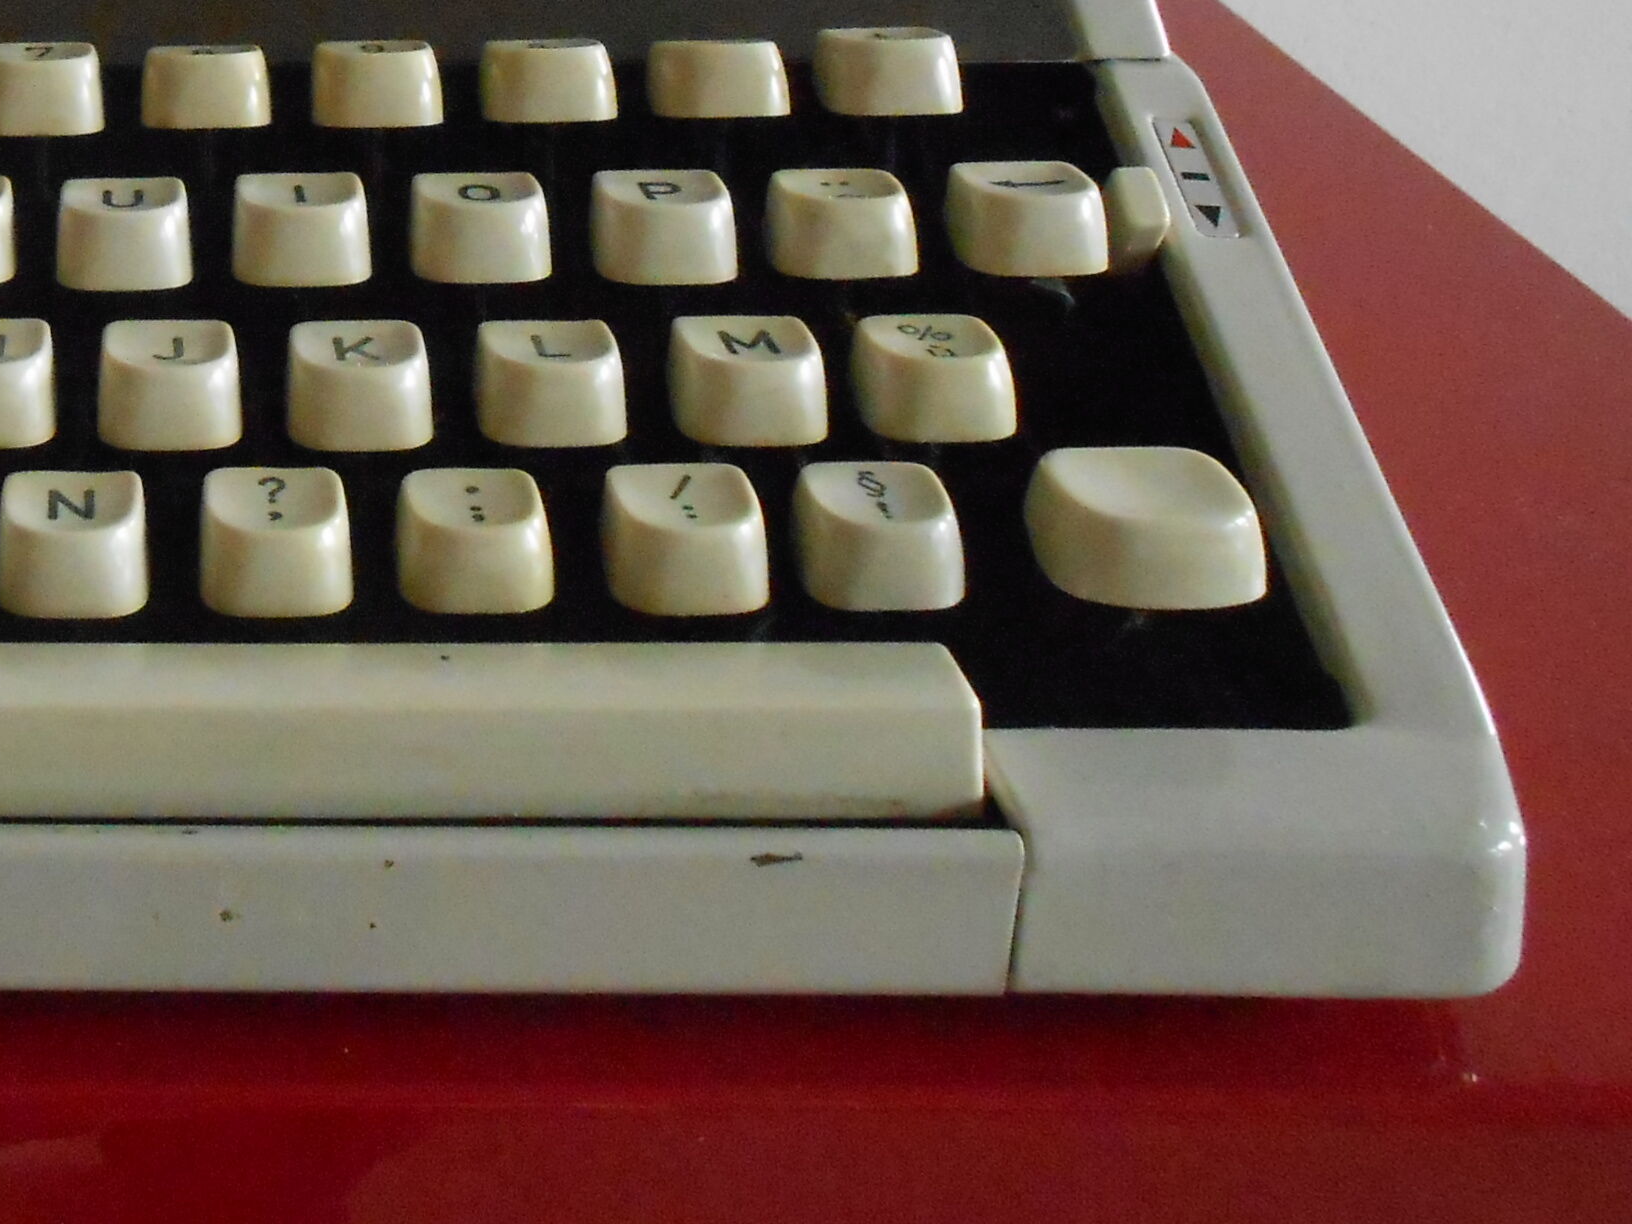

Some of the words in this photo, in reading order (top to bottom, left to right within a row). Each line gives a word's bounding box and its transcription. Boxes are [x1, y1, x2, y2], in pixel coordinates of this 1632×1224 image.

[99, 188, 141, 207] U
[457, 183, 499, 201] O
[638, 181, 681, 200] P
[152, 336, 184, 360] J
[332, 336, 380, 361] K
[531, 334, 572, 357] L
[717, 329, 781, 356] M
[258, 476, 286, 504] ?
[48, 489, 95, 521] N
